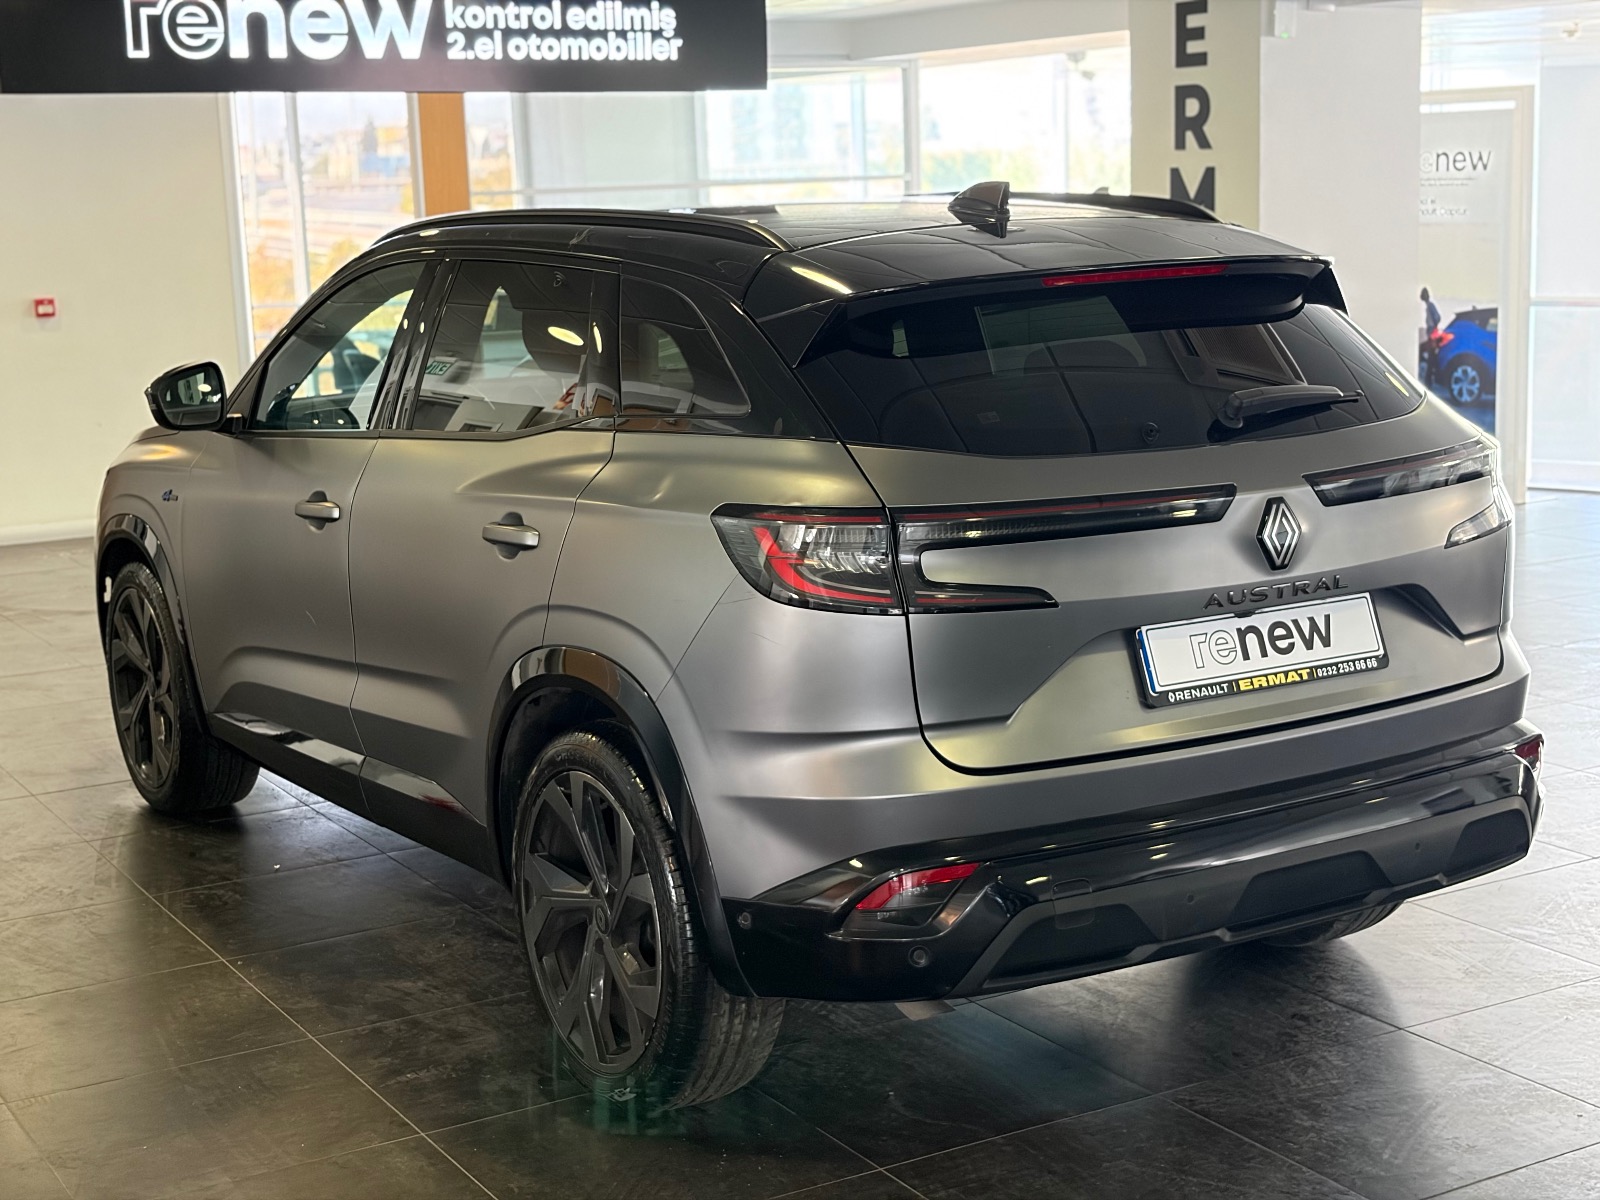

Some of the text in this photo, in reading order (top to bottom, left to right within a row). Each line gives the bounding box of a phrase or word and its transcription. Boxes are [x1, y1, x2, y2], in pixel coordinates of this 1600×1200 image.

[124, 0, 433, 60] renew
[445, 0, 677, 38] kontrol edilmiş
[447, 31, 683, 61] 2.el otomobiller
[1420, 150, 1491, 173] enew
[1203, 575, 1348, 610] AUSTRAL
[1189, 614, 1332, 669] renew
[1176, 656, 1378, 701] RENAULT ERMAT 0232 253 66 66
